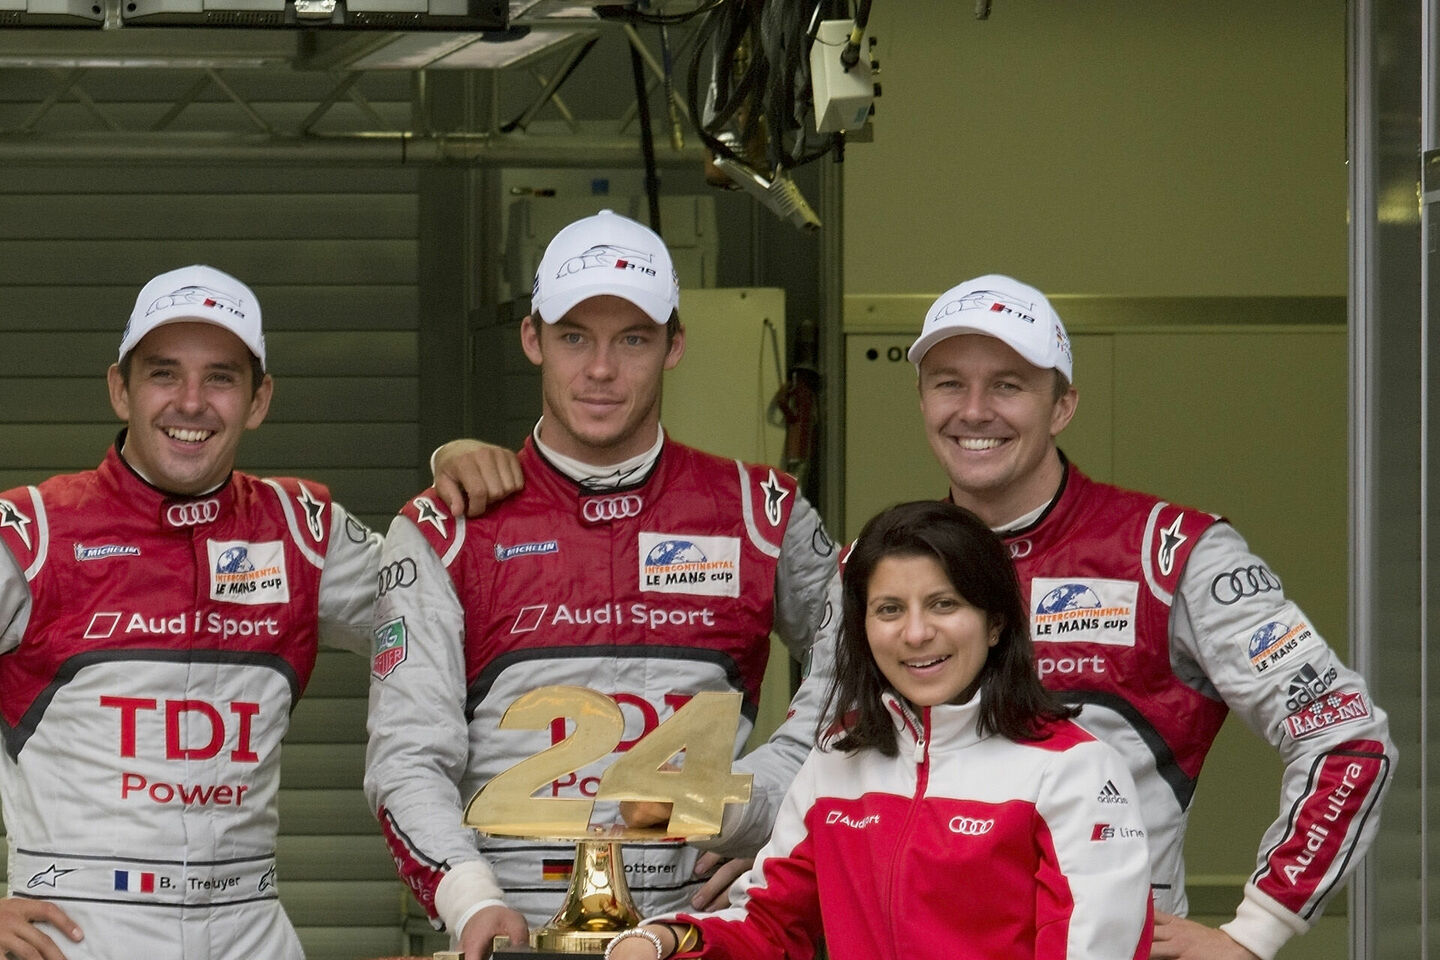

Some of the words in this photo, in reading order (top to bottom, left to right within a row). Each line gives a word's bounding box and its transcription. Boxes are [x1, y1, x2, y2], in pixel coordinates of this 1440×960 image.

[88, 546, 137, 557] MICHELIN
[507, 543, 555, 556] MICHELIN
[645, 561, 734, 574] INTERCONTINENTAL
[216, 583, 226, 594] LE
[229, 581, 256, 594] MANS
[261, 578, 282, 589] cup
[646, 575, 660, 586] LE
[665, 572, 706, 585] MANS
[711, 572, 733, 582] cup
[551, 604, 622, 626] Audi
[632, 604, 715, 628] Sport
[1035, 608, 1130, 623] INTERCONTINENTAL
[124, 611, 202, 634] Audi
[207, 613, 280, 639] Sport
[1036, 624, 1052, 636] LE
[1057, 619, 1099, 634] MANS
[1103, 619, 1128, 632] cup
[1256, 659, 1269, 672] LE
[1270, 638, 1298, 664] MANS
[1299, 630, 1312, 641] cup
[1037, 654, 1105, 681] port
[1286, 666, 1338, 711] adidas
[1289, 693, 1369, 736] RACE-INN
[100, 695, 259, 763] TDI
[463, 685, 754, 834] 24
[121, 773, 249, 806] Power
[1097, 795, 1128, 804] adidas
[1120, 827, 1145, 838] line
[1283, 824, 1329, 886] Audi
[1323, 762, 1363, 823] ultra
[624, 863, 676, 873] otterer
[160, 876, 176, 889] B.
